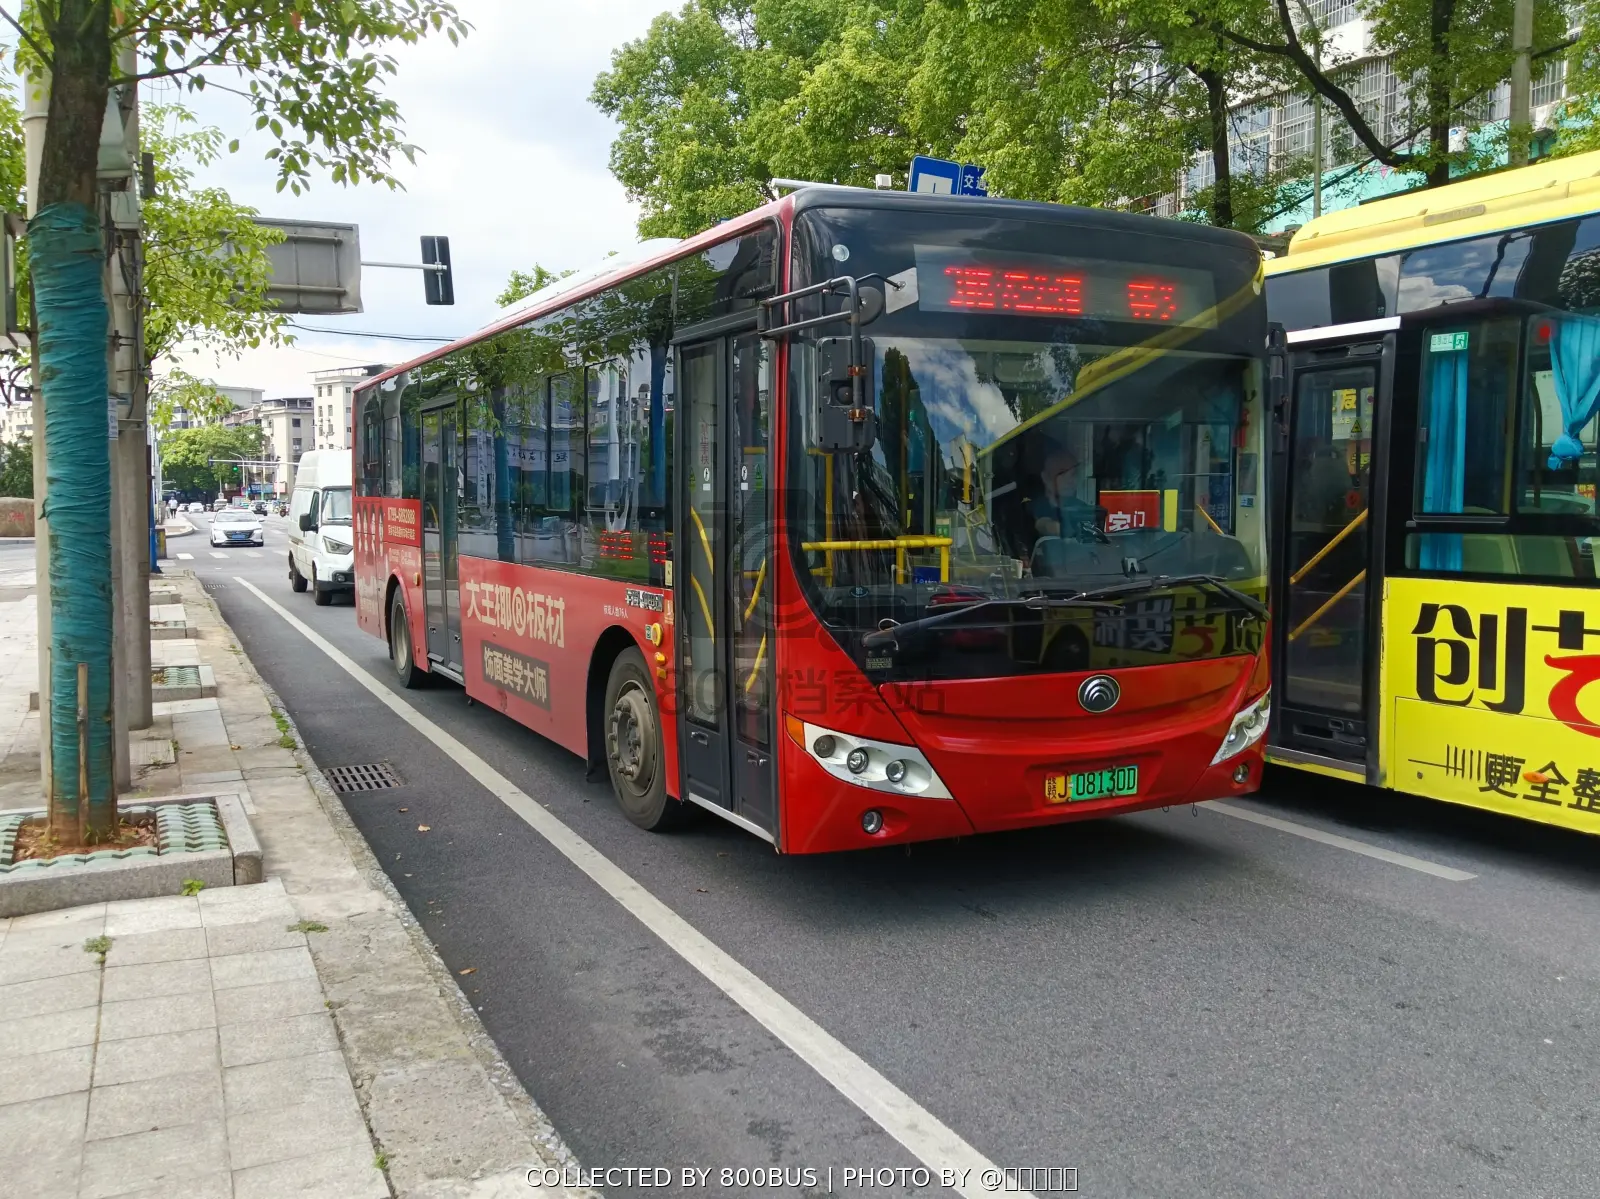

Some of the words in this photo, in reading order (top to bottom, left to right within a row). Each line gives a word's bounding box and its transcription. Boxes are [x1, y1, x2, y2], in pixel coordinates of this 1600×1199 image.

[483, 646, 548, 704] 饰面美学大师
